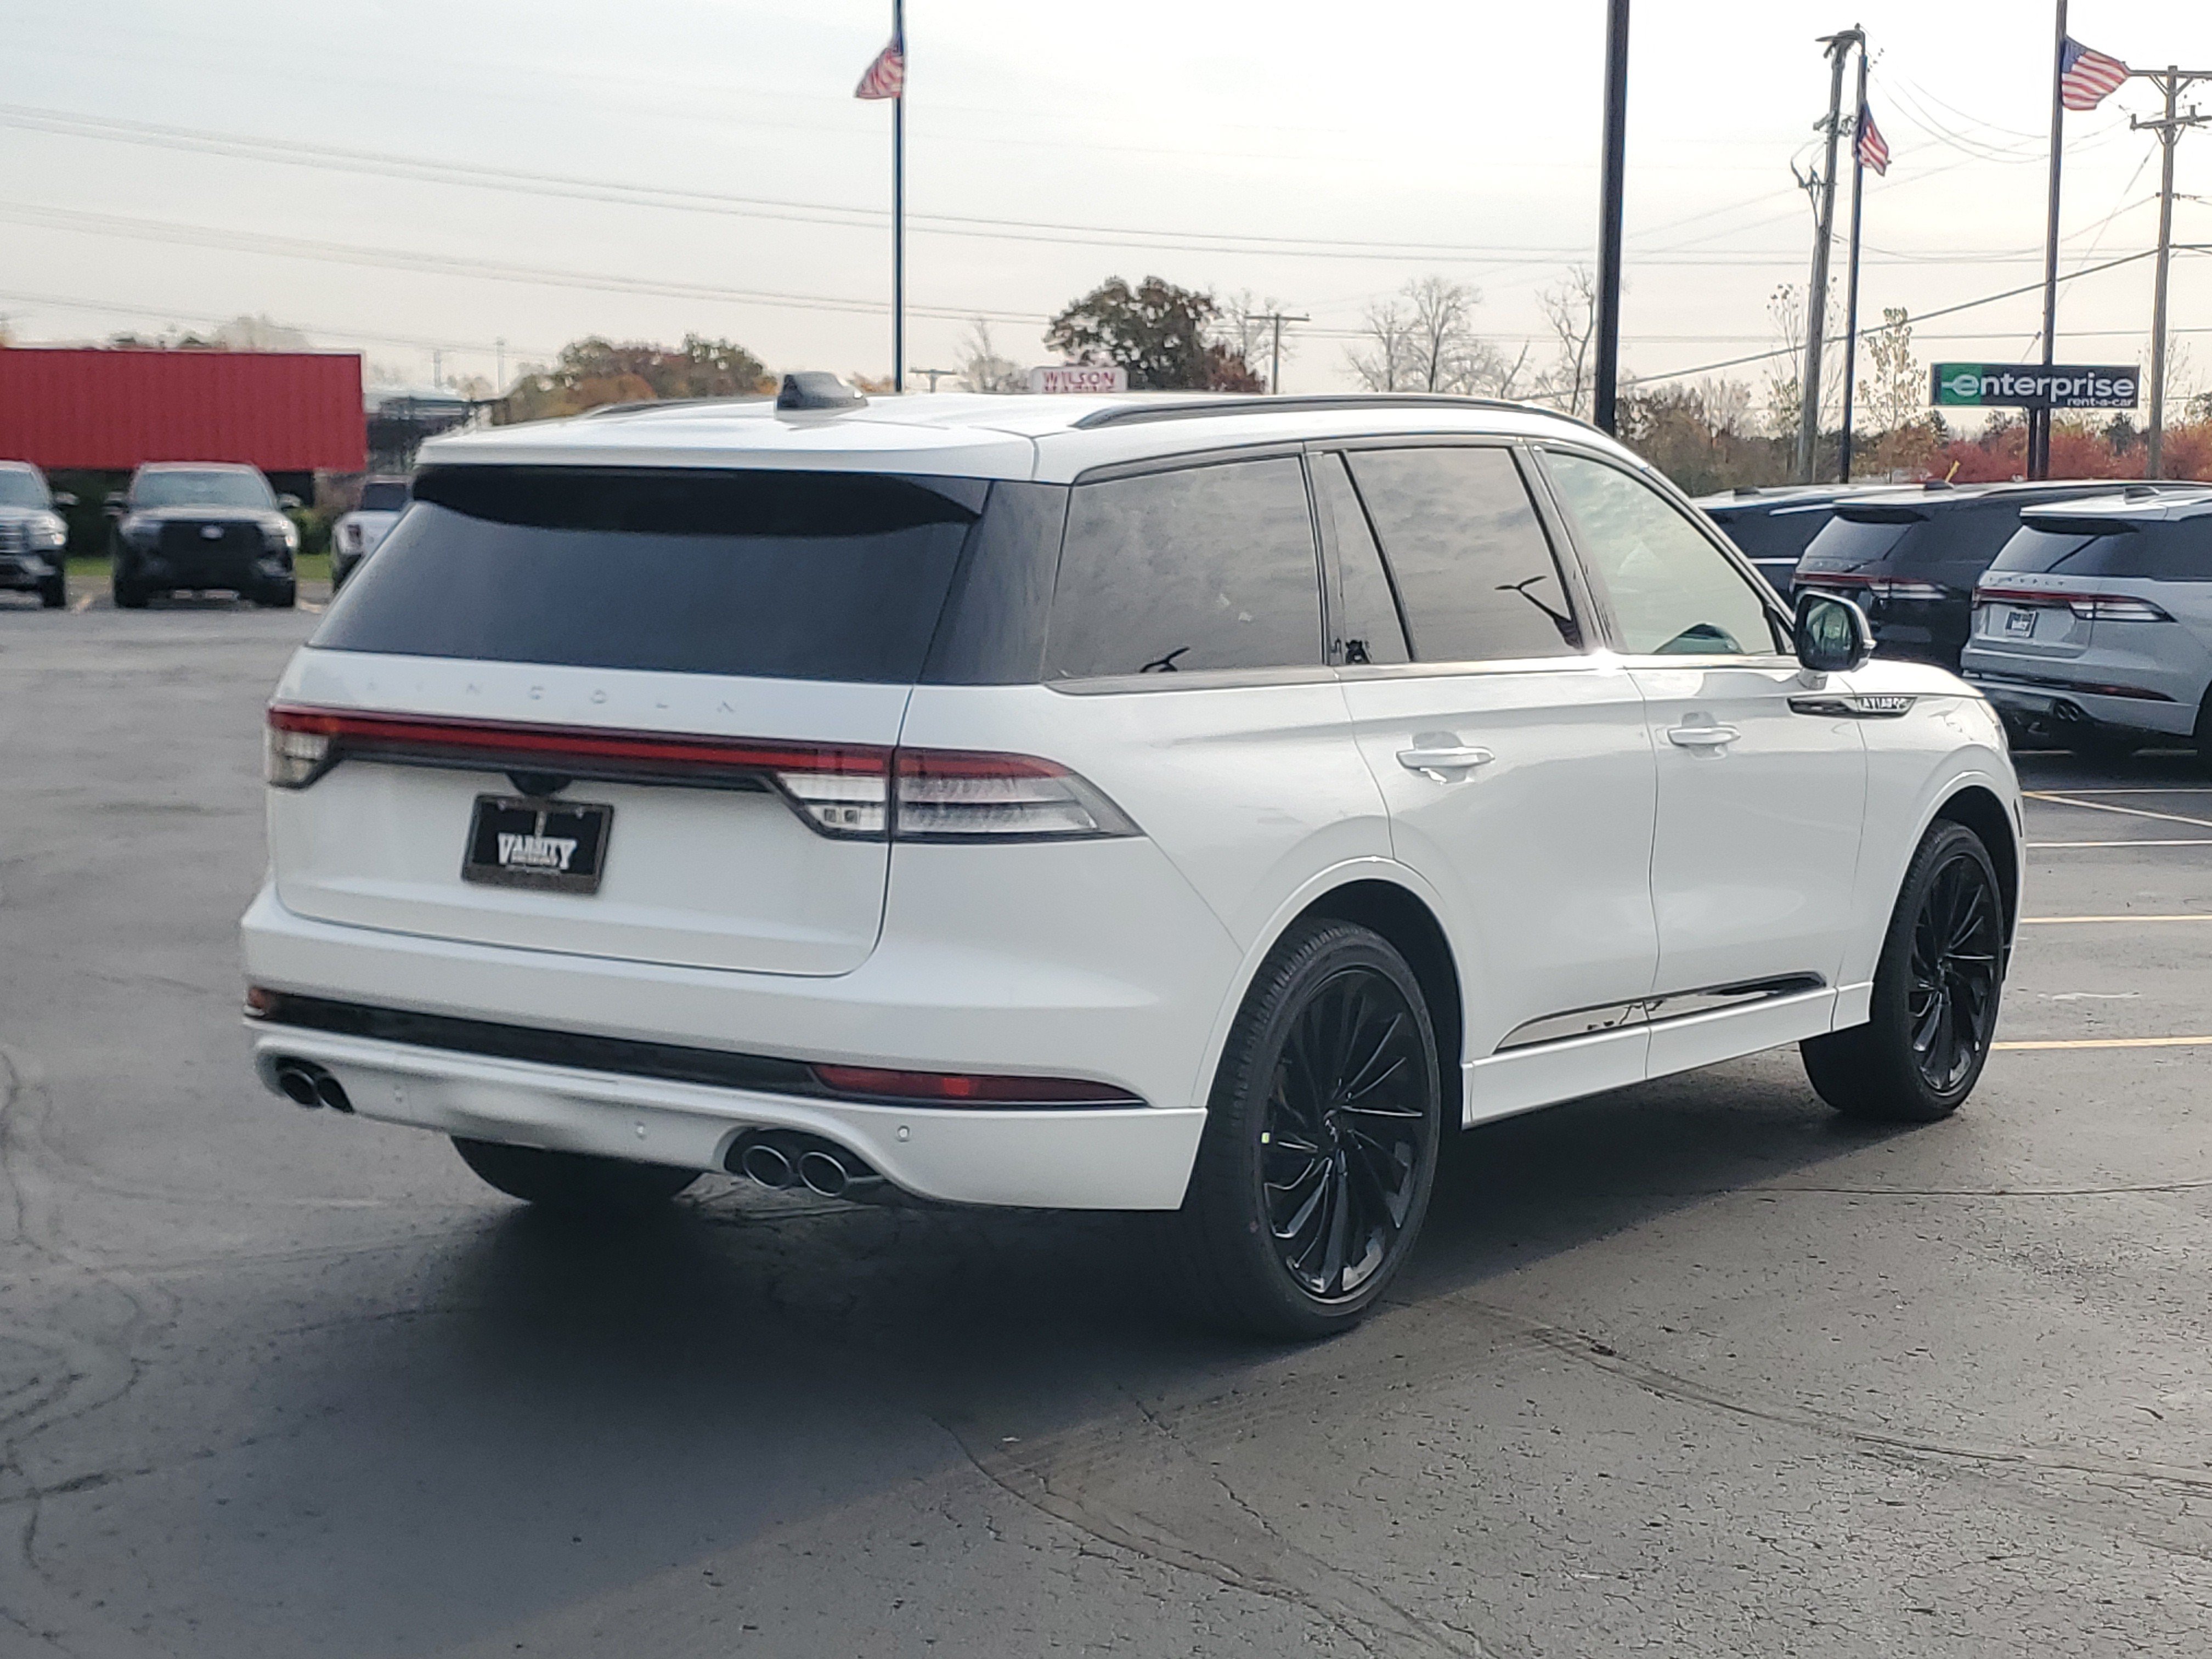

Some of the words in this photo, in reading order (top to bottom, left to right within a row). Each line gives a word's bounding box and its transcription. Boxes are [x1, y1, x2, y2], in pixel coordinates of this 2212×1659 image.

[1043, 371, 1116, 385] WILSON
[1942, 372, 2135, 402] enterprise
[2067, 397, 2134, 407] rent-a-car
